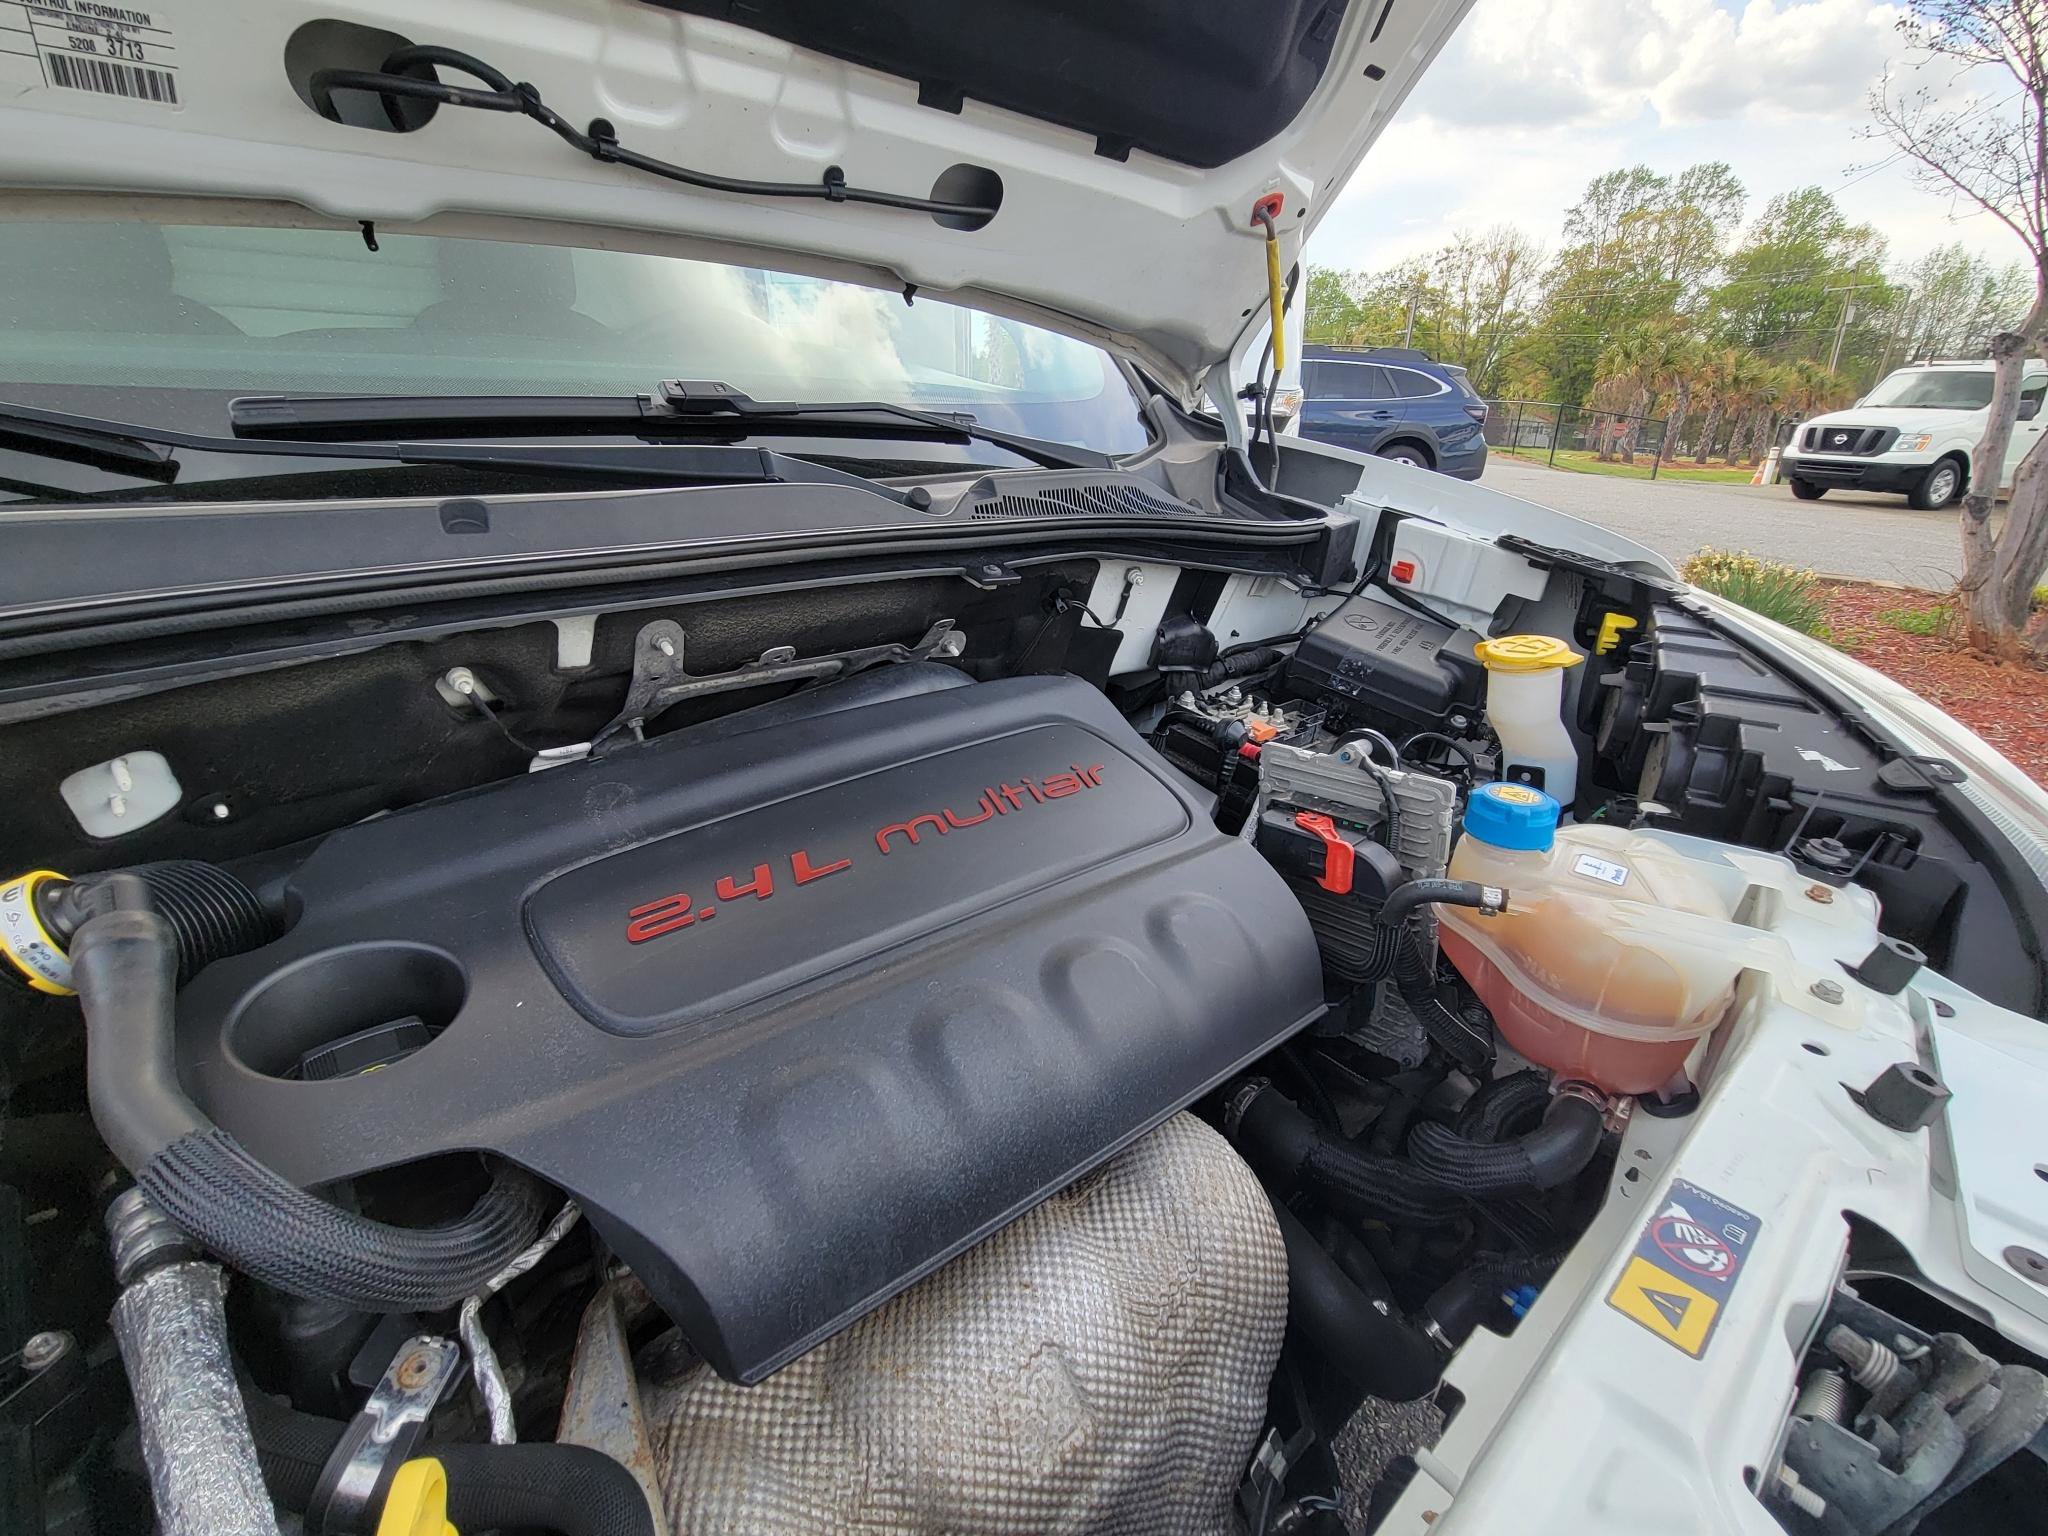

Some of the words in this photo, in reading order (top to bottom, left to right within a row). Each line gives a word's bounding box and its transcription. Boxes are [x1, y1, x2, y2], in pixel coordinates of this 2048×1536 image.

[74, 0, 151, 26] INFORMATION
[68, 36, 96, 52] 5208
[106, 36, 145, 61] 3713
[626, 863, 774, 944] 2.4
[791, 850, 852, 886] L
[875, 763, 1105, 855] multiair
